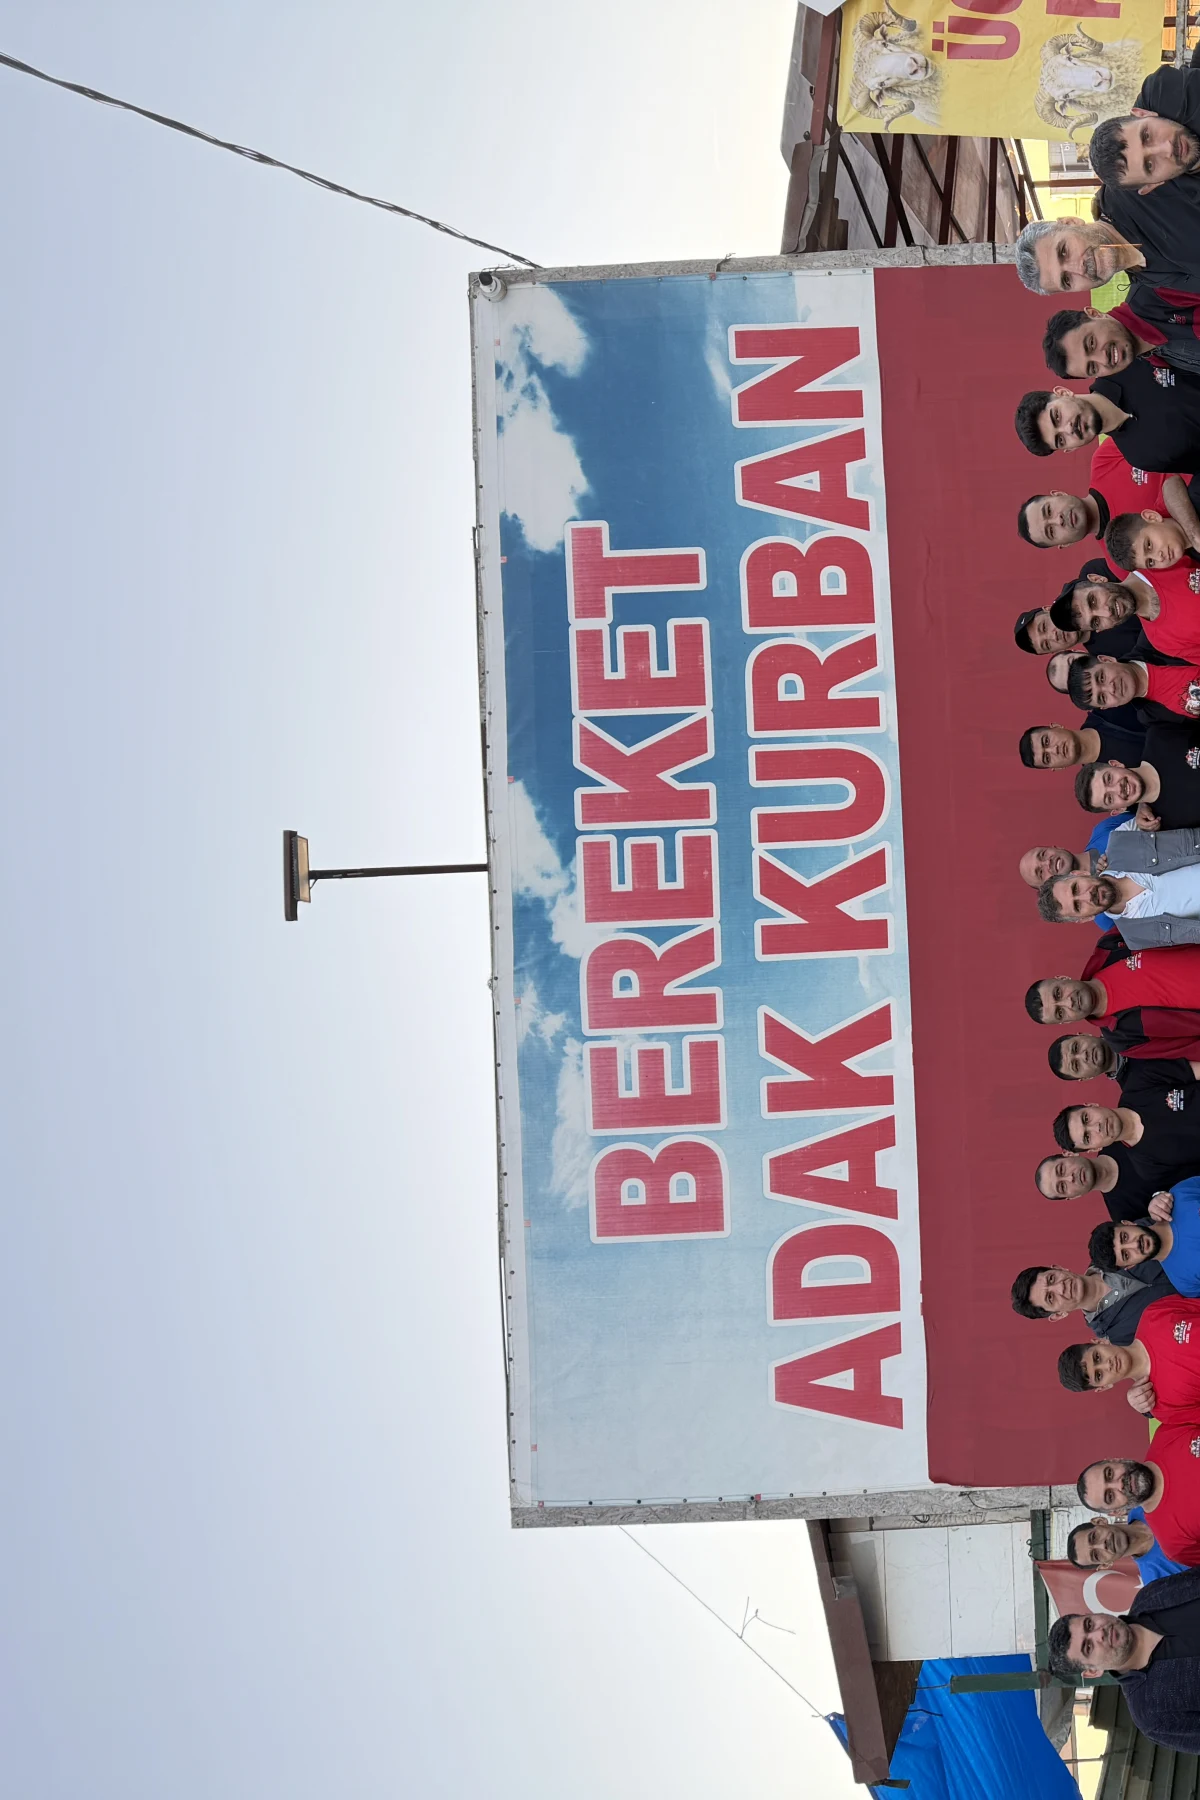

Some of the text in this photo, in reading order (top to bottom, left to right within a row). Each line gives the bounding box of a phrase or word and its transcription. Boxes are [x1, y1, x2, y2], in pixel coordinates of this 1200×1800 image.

[569, 522, 728, 1241] BEREKET
[731, 325, 904, 1432] ADAK KURBAN
